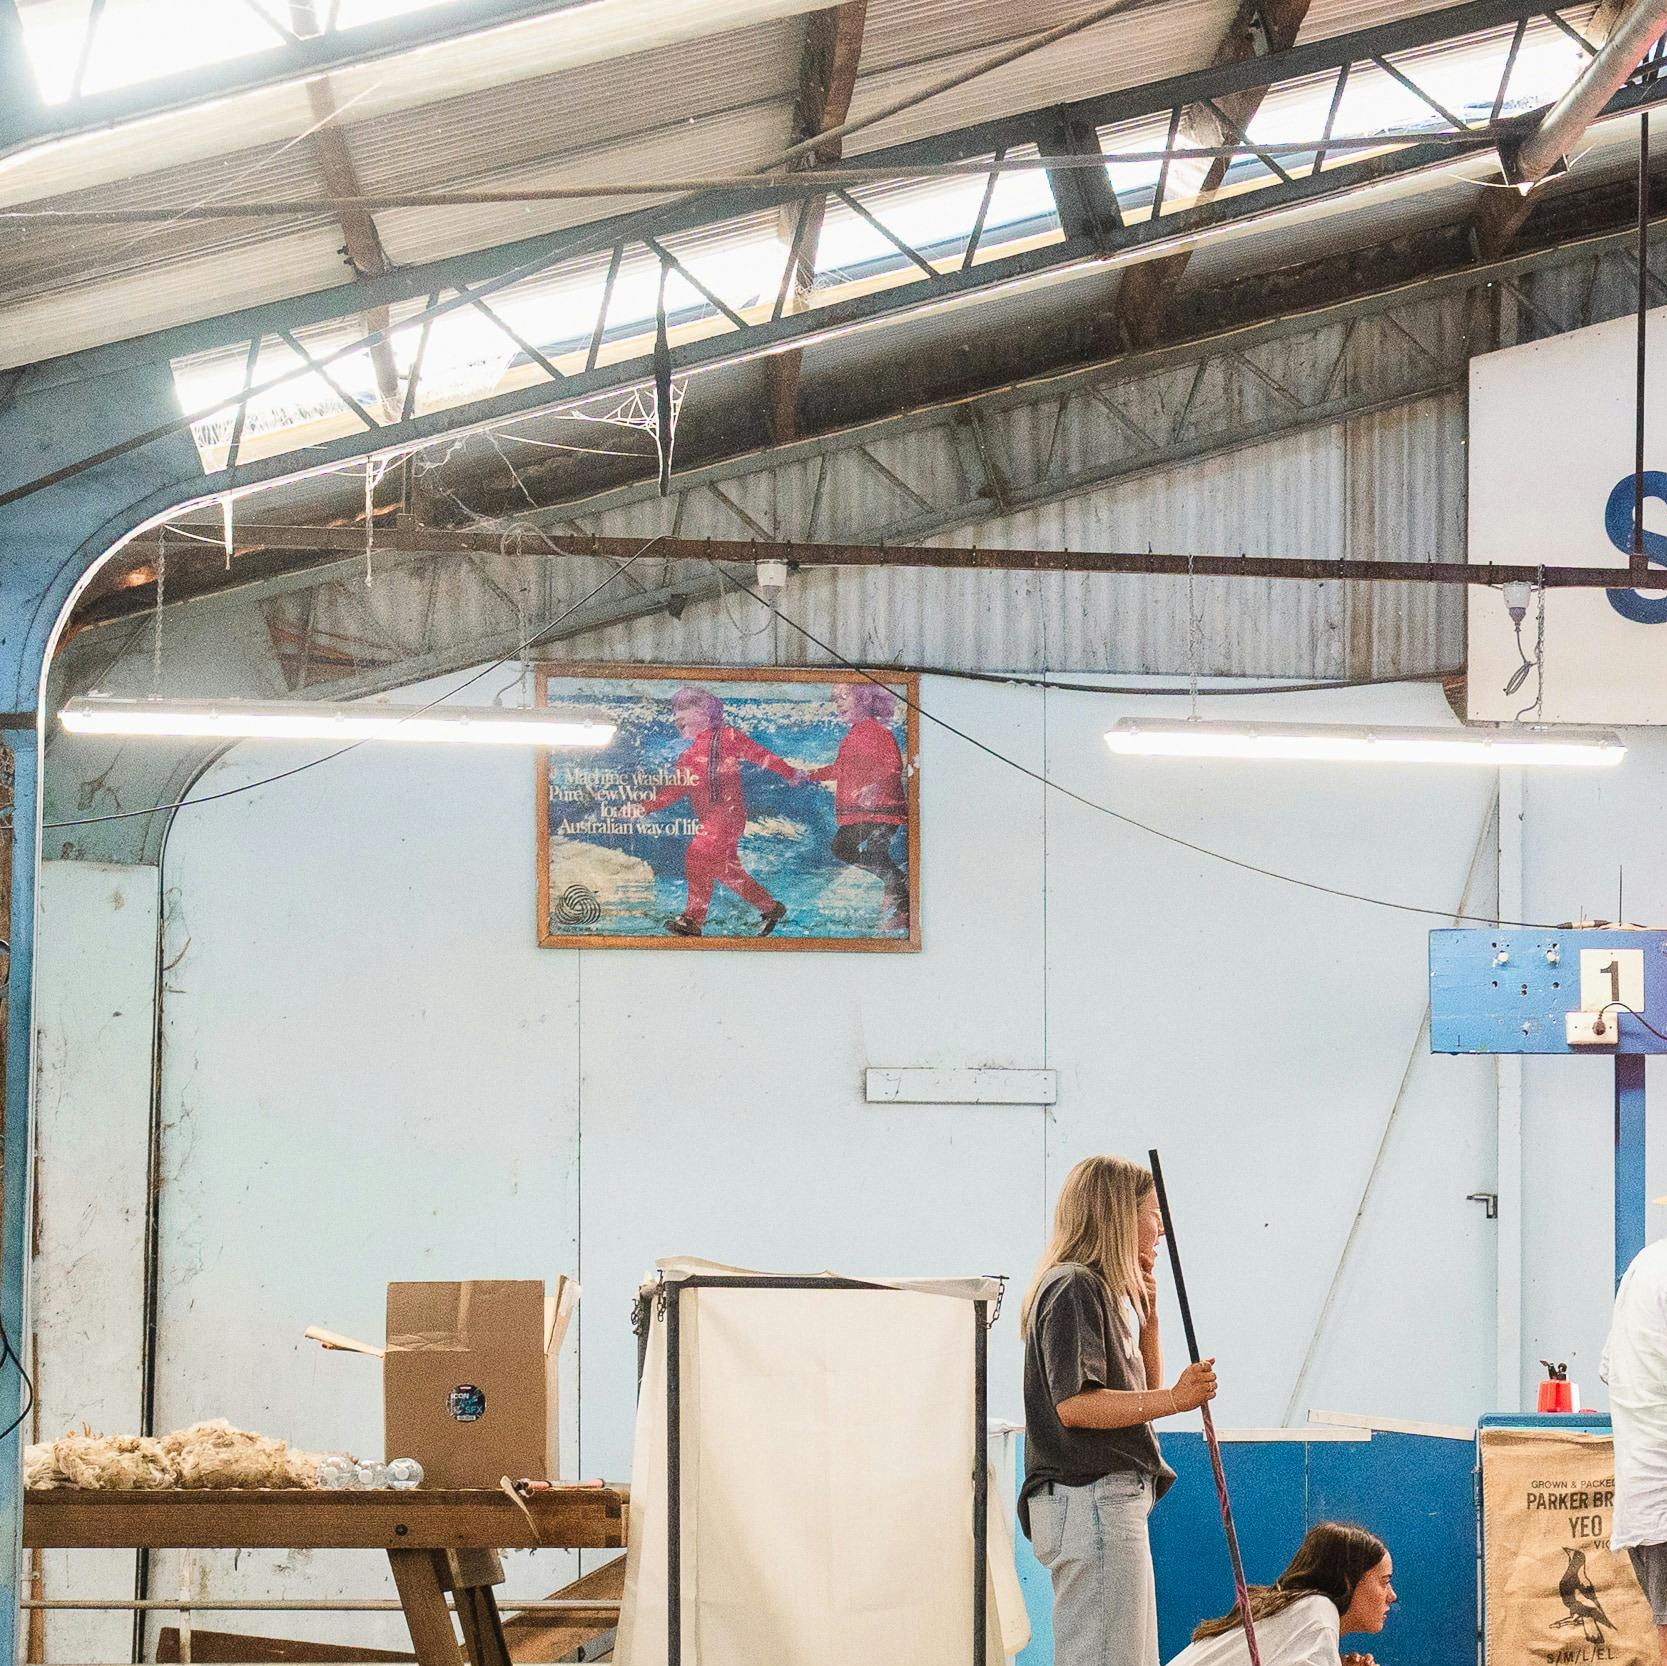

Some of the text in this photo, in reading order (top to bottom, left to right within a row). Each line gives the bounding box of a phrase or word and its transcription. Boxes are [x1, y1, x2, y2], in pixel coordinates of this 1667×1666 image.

[632, 768, 700, 787] washable
[618, 785, 657, 801] Wool
[600, 801, 645, 819] for the
[559, 818, 708, 838] Australian way of life.
[1600, 961, 1619, 1002] 1
[1530, 1480, 1568, 1489] GROWN
[1570, 1480, 1578, 1489] &
[1526, 1491, 1589, 1511] PARKER
[1568, 1515, 1603, 1538] YEO
